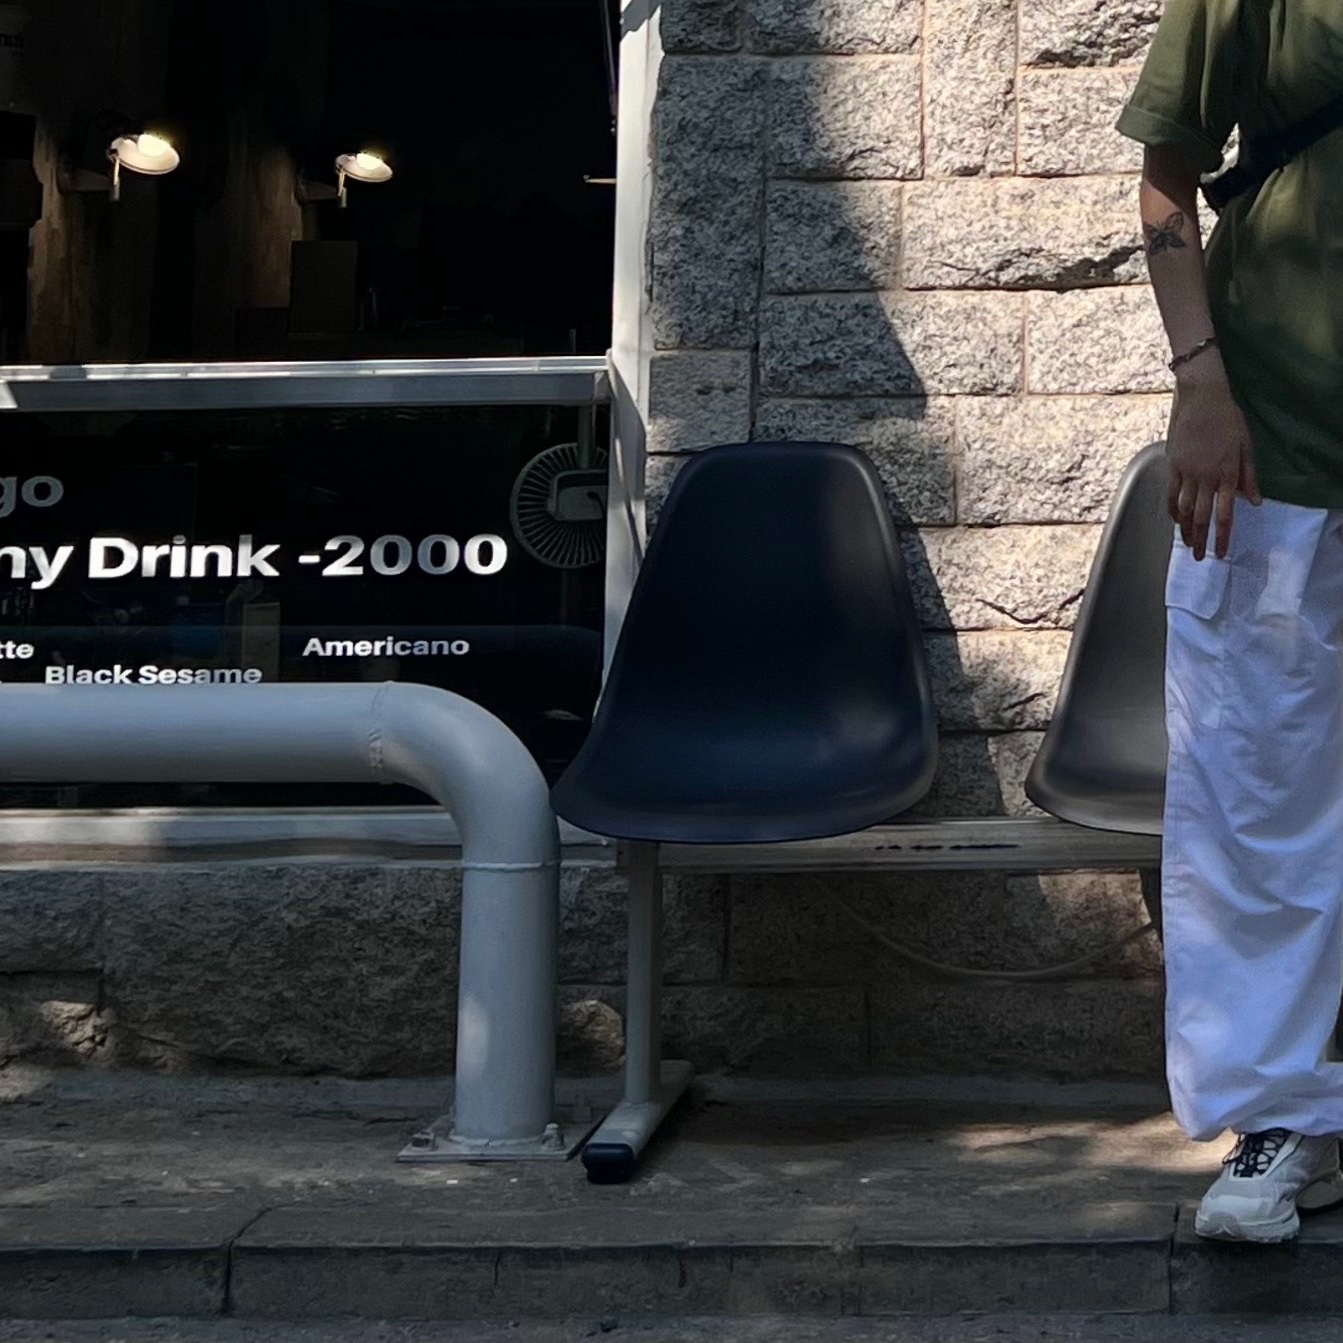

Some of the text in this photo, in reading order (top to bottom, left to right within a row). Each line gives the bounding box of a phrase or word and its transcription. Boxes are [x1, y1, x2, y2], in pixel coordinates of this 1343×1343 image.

[88, 534, 282, 579] Drink
[298, 533, 509, 577] -2000
[302, 636, 470, 657] Americano
[45, 664, 263, 685] Black Sesame
